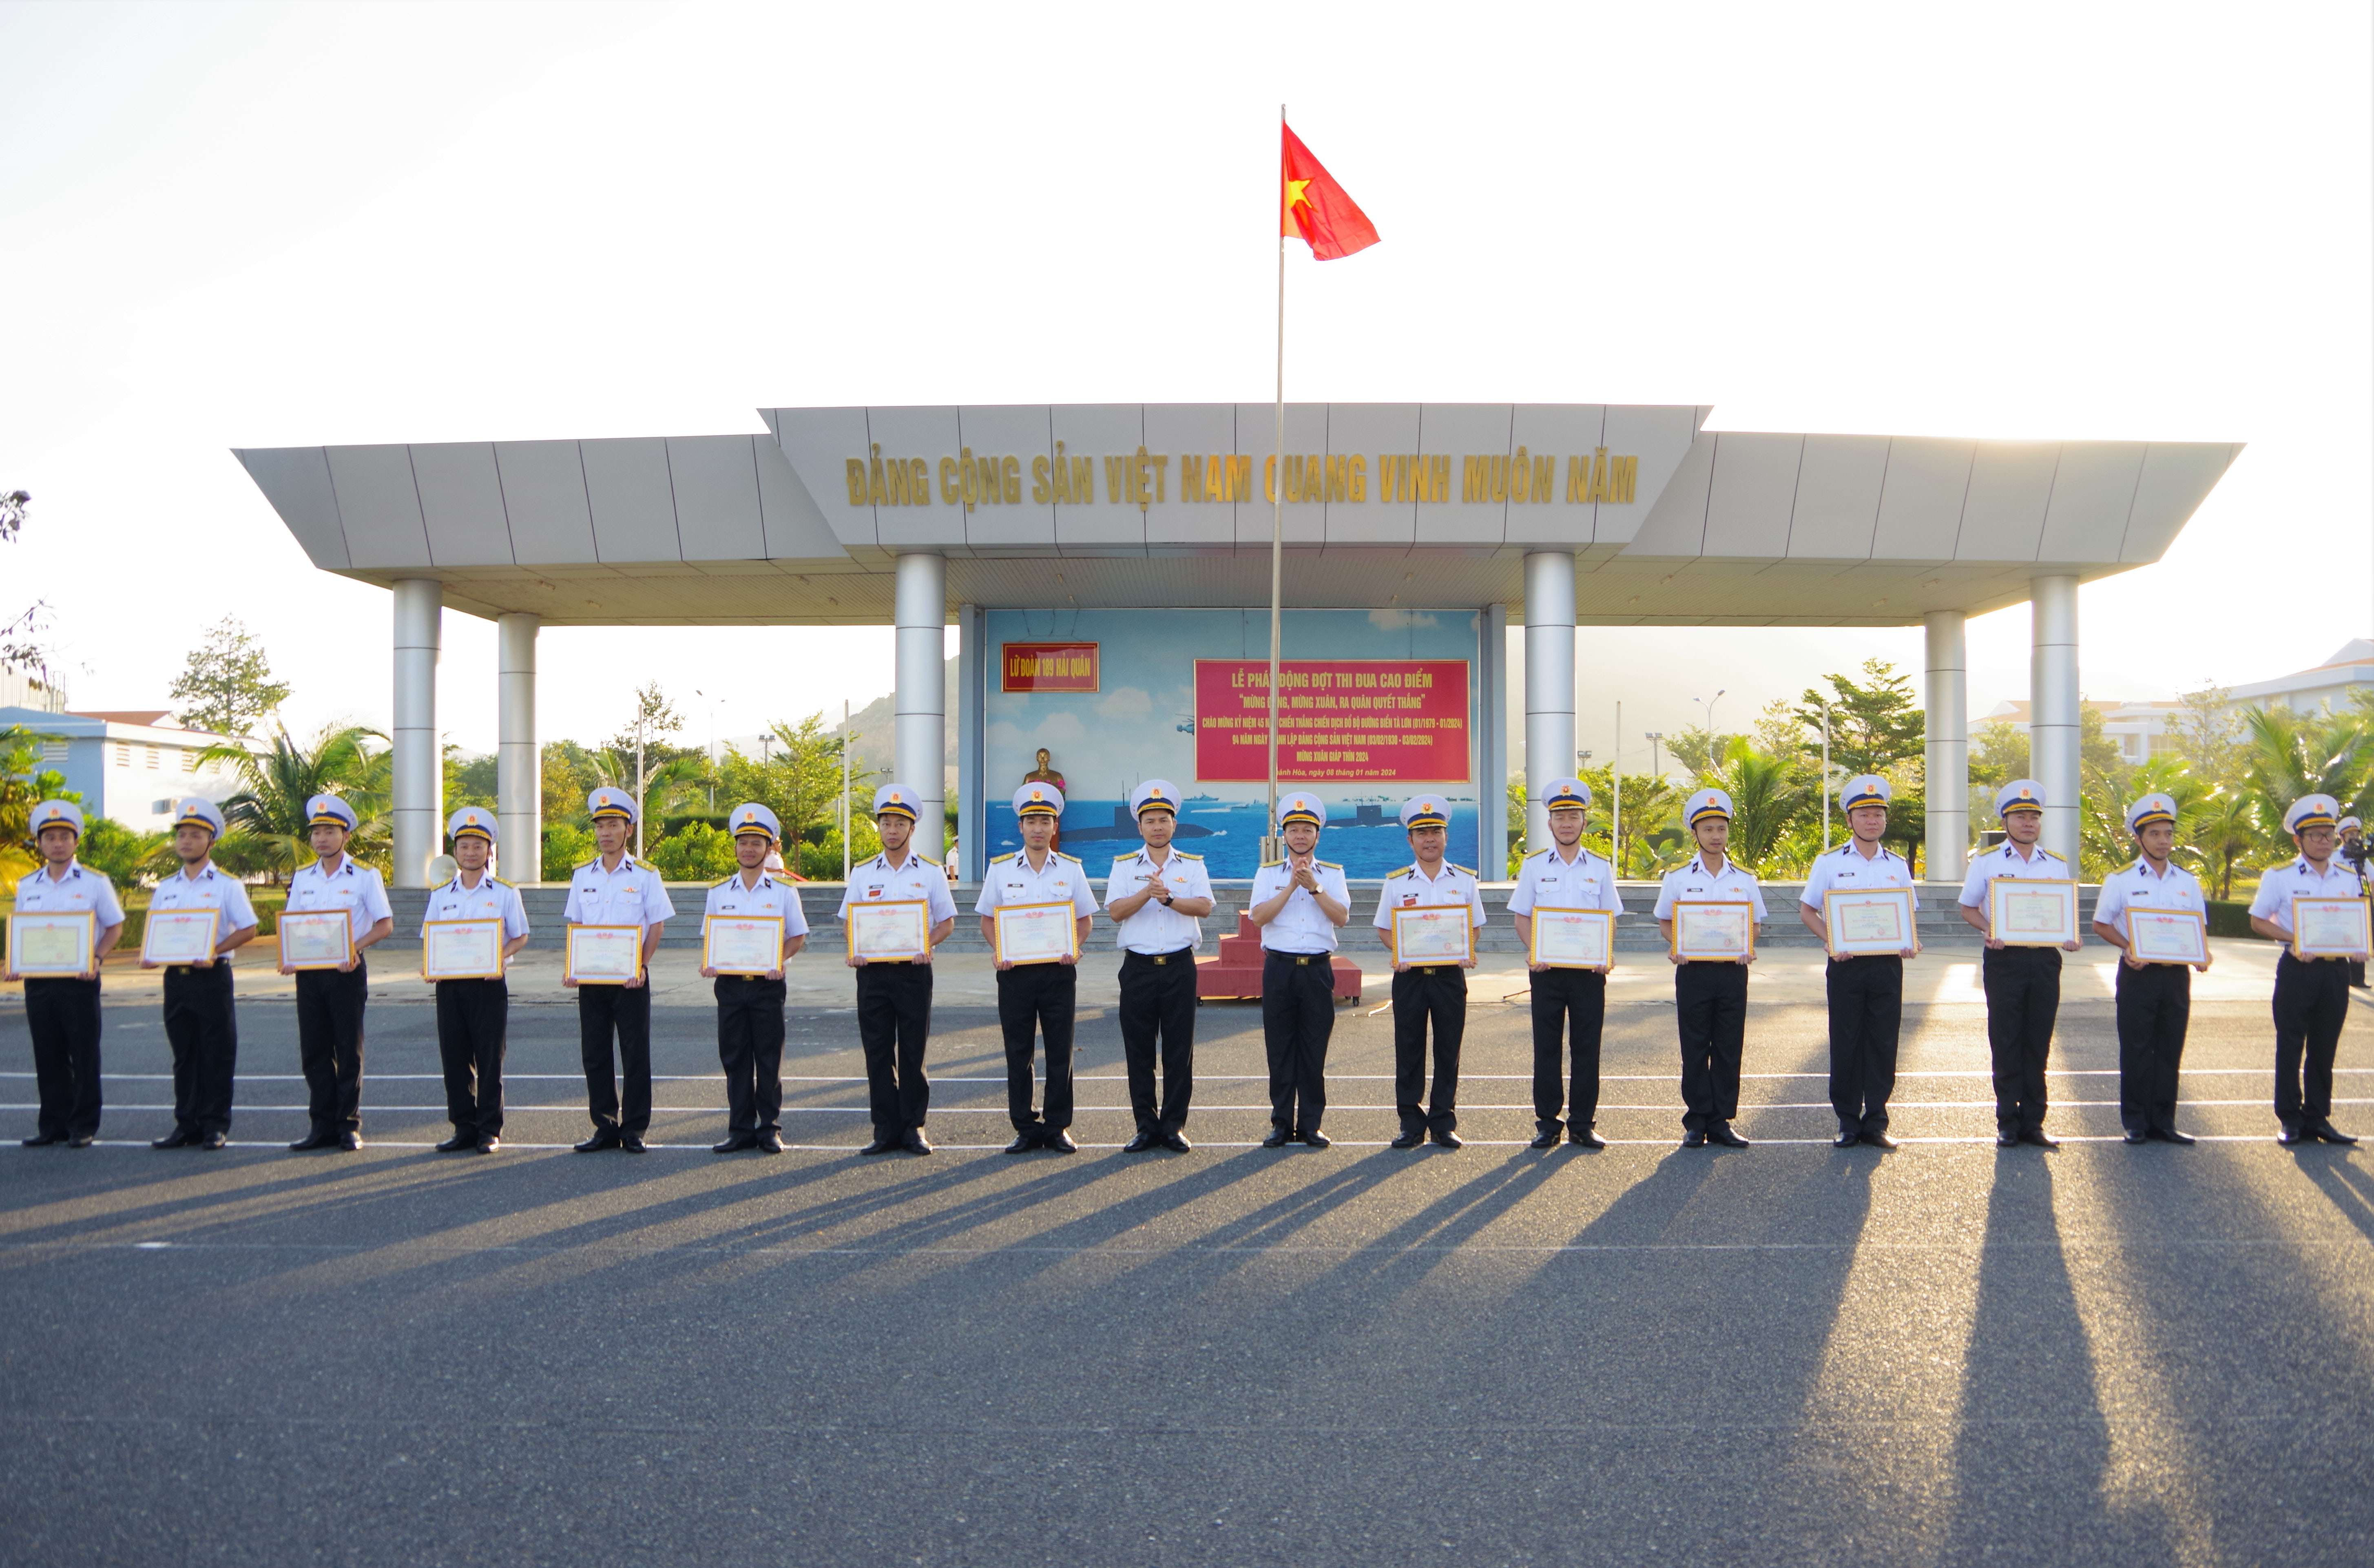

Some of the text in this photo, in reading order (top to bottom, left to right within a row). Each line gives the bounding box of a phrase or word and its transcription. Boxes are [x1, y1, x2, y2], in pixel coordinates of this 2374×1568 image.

[846, 442, 930, 506] ĐẢNG
[939, 446, 1021, 513] CỘNG
[1032, 440, 1093, 504] SẢN
[1104, 445, 1168, 512] VIỆT
[1181, 455, 1251, 503] NAM
[1380, 455, 1451, 502] VINH
[1462, 446, 1555, 503] MUÔN
[1566, 447, 1638, 503] NĂM
[1010, 652, 1091, 679] LỮ ĐOÀN 189 HẢI QUÂN
[1232, 668, 1432, 691] LỄ PHÁ ĐỘNG ĐỢT THI ĐUA CAO ĐIỂM
[1291, 694, 1314, 708] MỪNG
[1316, 694, 1338, 710] XUÂN,
[1339, 697, 1350, 708] RA
[1351, 694, 1371, 710] QUÂN
[1373, 693, 1396, 710] QUYẾT
[1203, 716, 1217, 728] CHÀO
[1217, 716, 1234, 728] MỪNG
[1243, 716, 1256, 730] NIỆM
[1257, 718, 1264, 728] 45
[1279, 714, 1294, 728] CHIẾN
[1295, 714, 1313, 728] THẮNG
[1314, 714, 1330, 728] CHIẾN
[1331, 718, 1343, 730] DỊCH
[1353, 716, 1360, 730] BỘ
[1361, 716, 1379, 728] ĐƯỜNG
[1380, 714, 1393, 728] BIỂN
[1394, 715, 1401, 728] TÀ
[1413, 718, 1436, 729] (01/1979
[1440, 718, 1462, 729] 01/2024)
[1232, 734, 1239, 745] 94
[1240, 733, 1252, 745] NĂM
[1254, 732, 1268, 745] NGÀY
[1287, 732, 1297, 747] LẬP
[1298, 732, 1313, 745] ĐẢNG
[1314, 732, 1328, 747] CỘNG
[1329, 731, 1341, 745] SẢN
[1341, 732, 1353, 747] VIỆT
[1354, 735, 1366, 745] NAM
[1367, 734, 1398, 746] (03/02/1930
[1402, 735, 1433, 746] 03/02/2024)
[1297, 750, 1369, 762] MỪNG XUÂN GIÁP THÌN 2024
[1309, 769, 1325, 777] ngày
[1336, 769, 1354, 777] tháng
